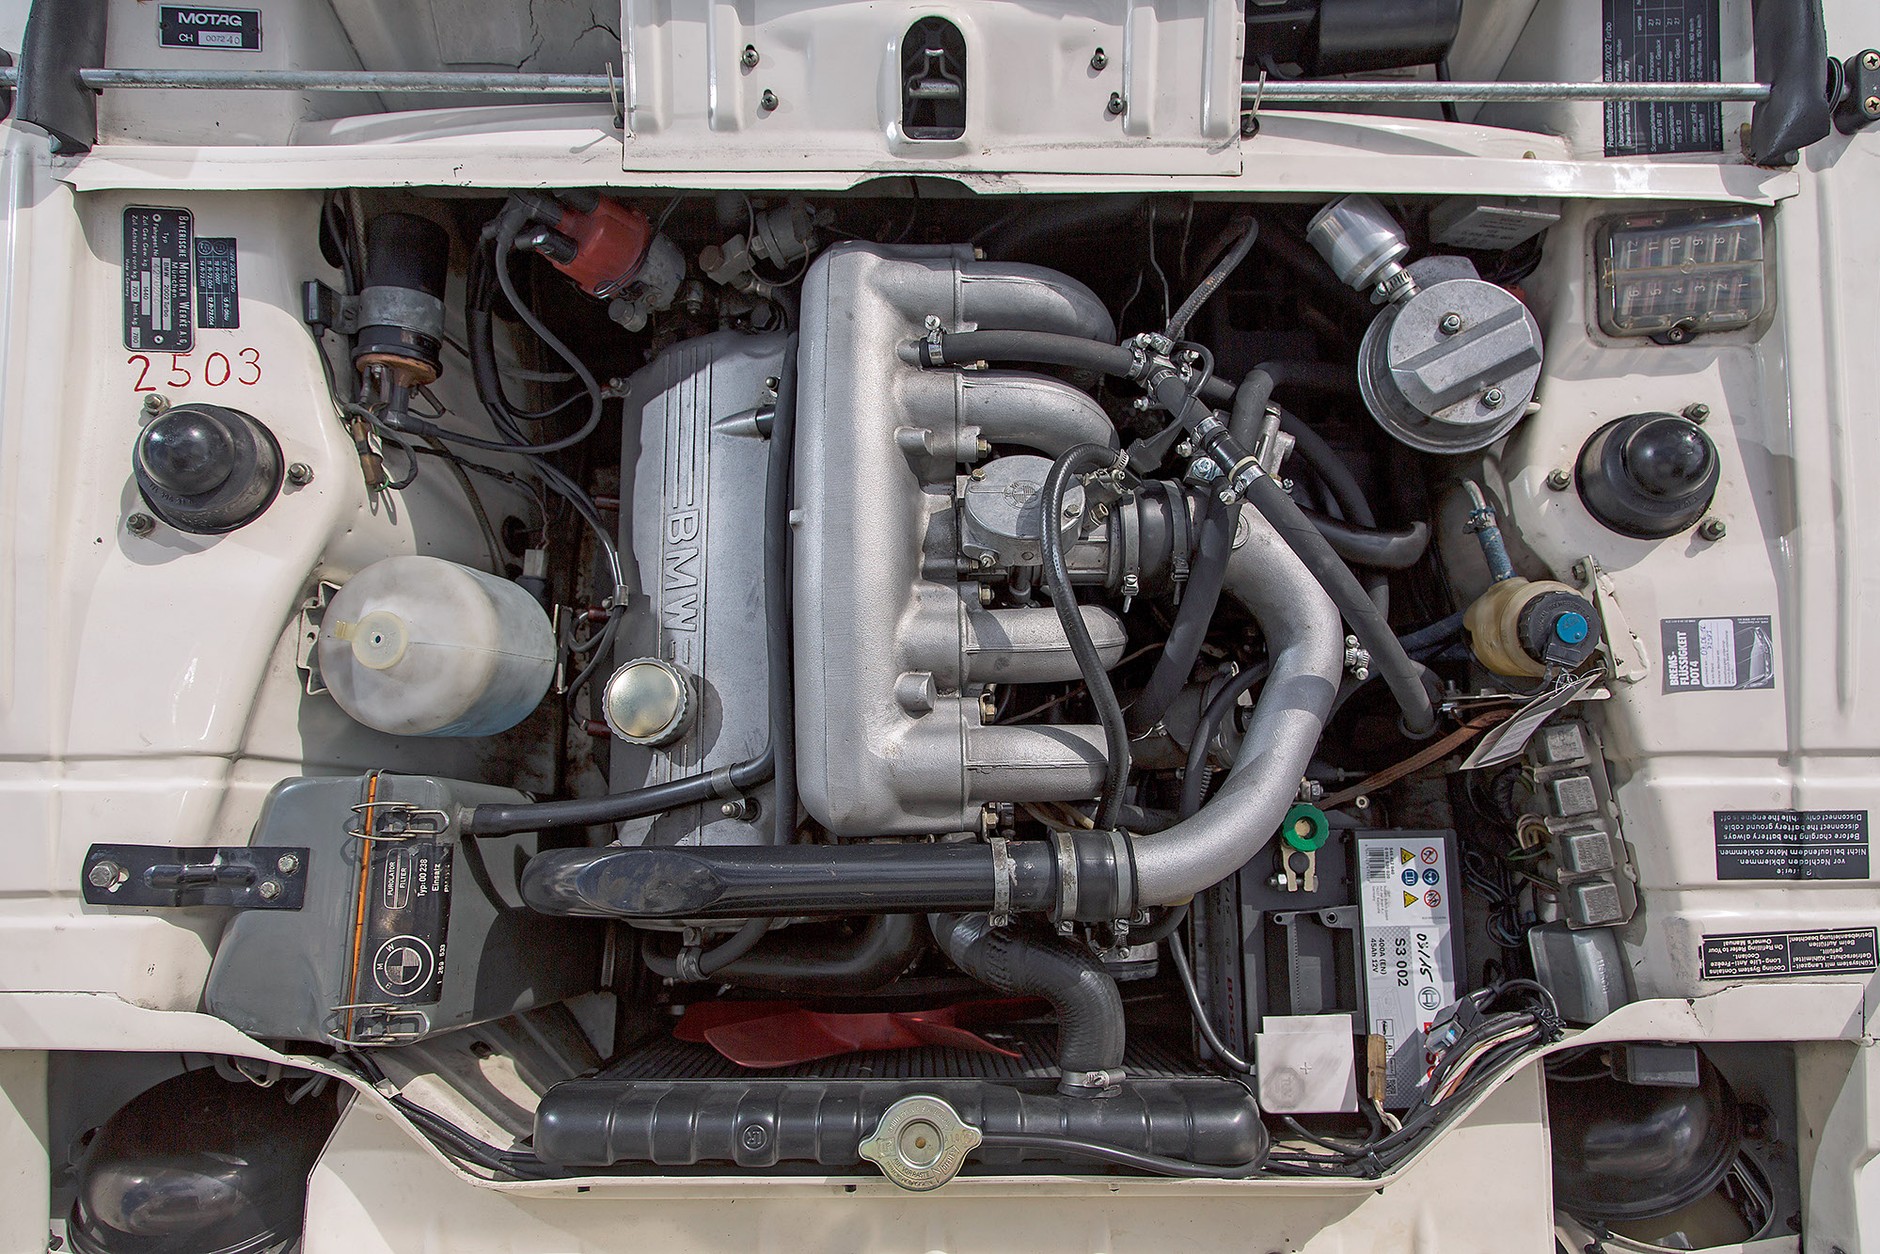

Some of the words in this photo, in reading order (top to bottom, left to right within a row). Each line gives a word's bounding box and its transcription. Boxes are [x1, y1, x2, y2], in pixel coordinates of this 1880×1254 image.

[178, 12, 242, 26] MOTAG
[179, 34, 193, 42] CH
[178, 216, 188, 257] BAYERISCHE
[1649, 241, 1658, 250] 11
[1670, 238, 1681, 249] 10
[178, 262, 188, 297] MOTOREN
[179, 302, 190, 327] WERKE
[128, 347, 261, 392] 2503
[664, 509, 699, 631] BMW
[1668, 652, 1679, 686] BREMS-
[1775, 823, 1805, 831] battery
[1753, 832, 1782, 841] battery
[1847, 848, 1866, 856] Nicht
[432, 863, 440, 891] Einsatz
[1789, 935, 1819, 943] beachten!
[1820, 932, 1872, 940] Betriebsanleitung
[1395, 938, 1406, 956] S3
[1379, 959, 1387, 975] (EN)
[1710, 960, 1747, 968] Anti-Freeze
[1762, 964, 1785, 972] Cooling
[1837, 959, 1873, 967] Kühlsystem
[1397, 961, 1408, 987] 002
